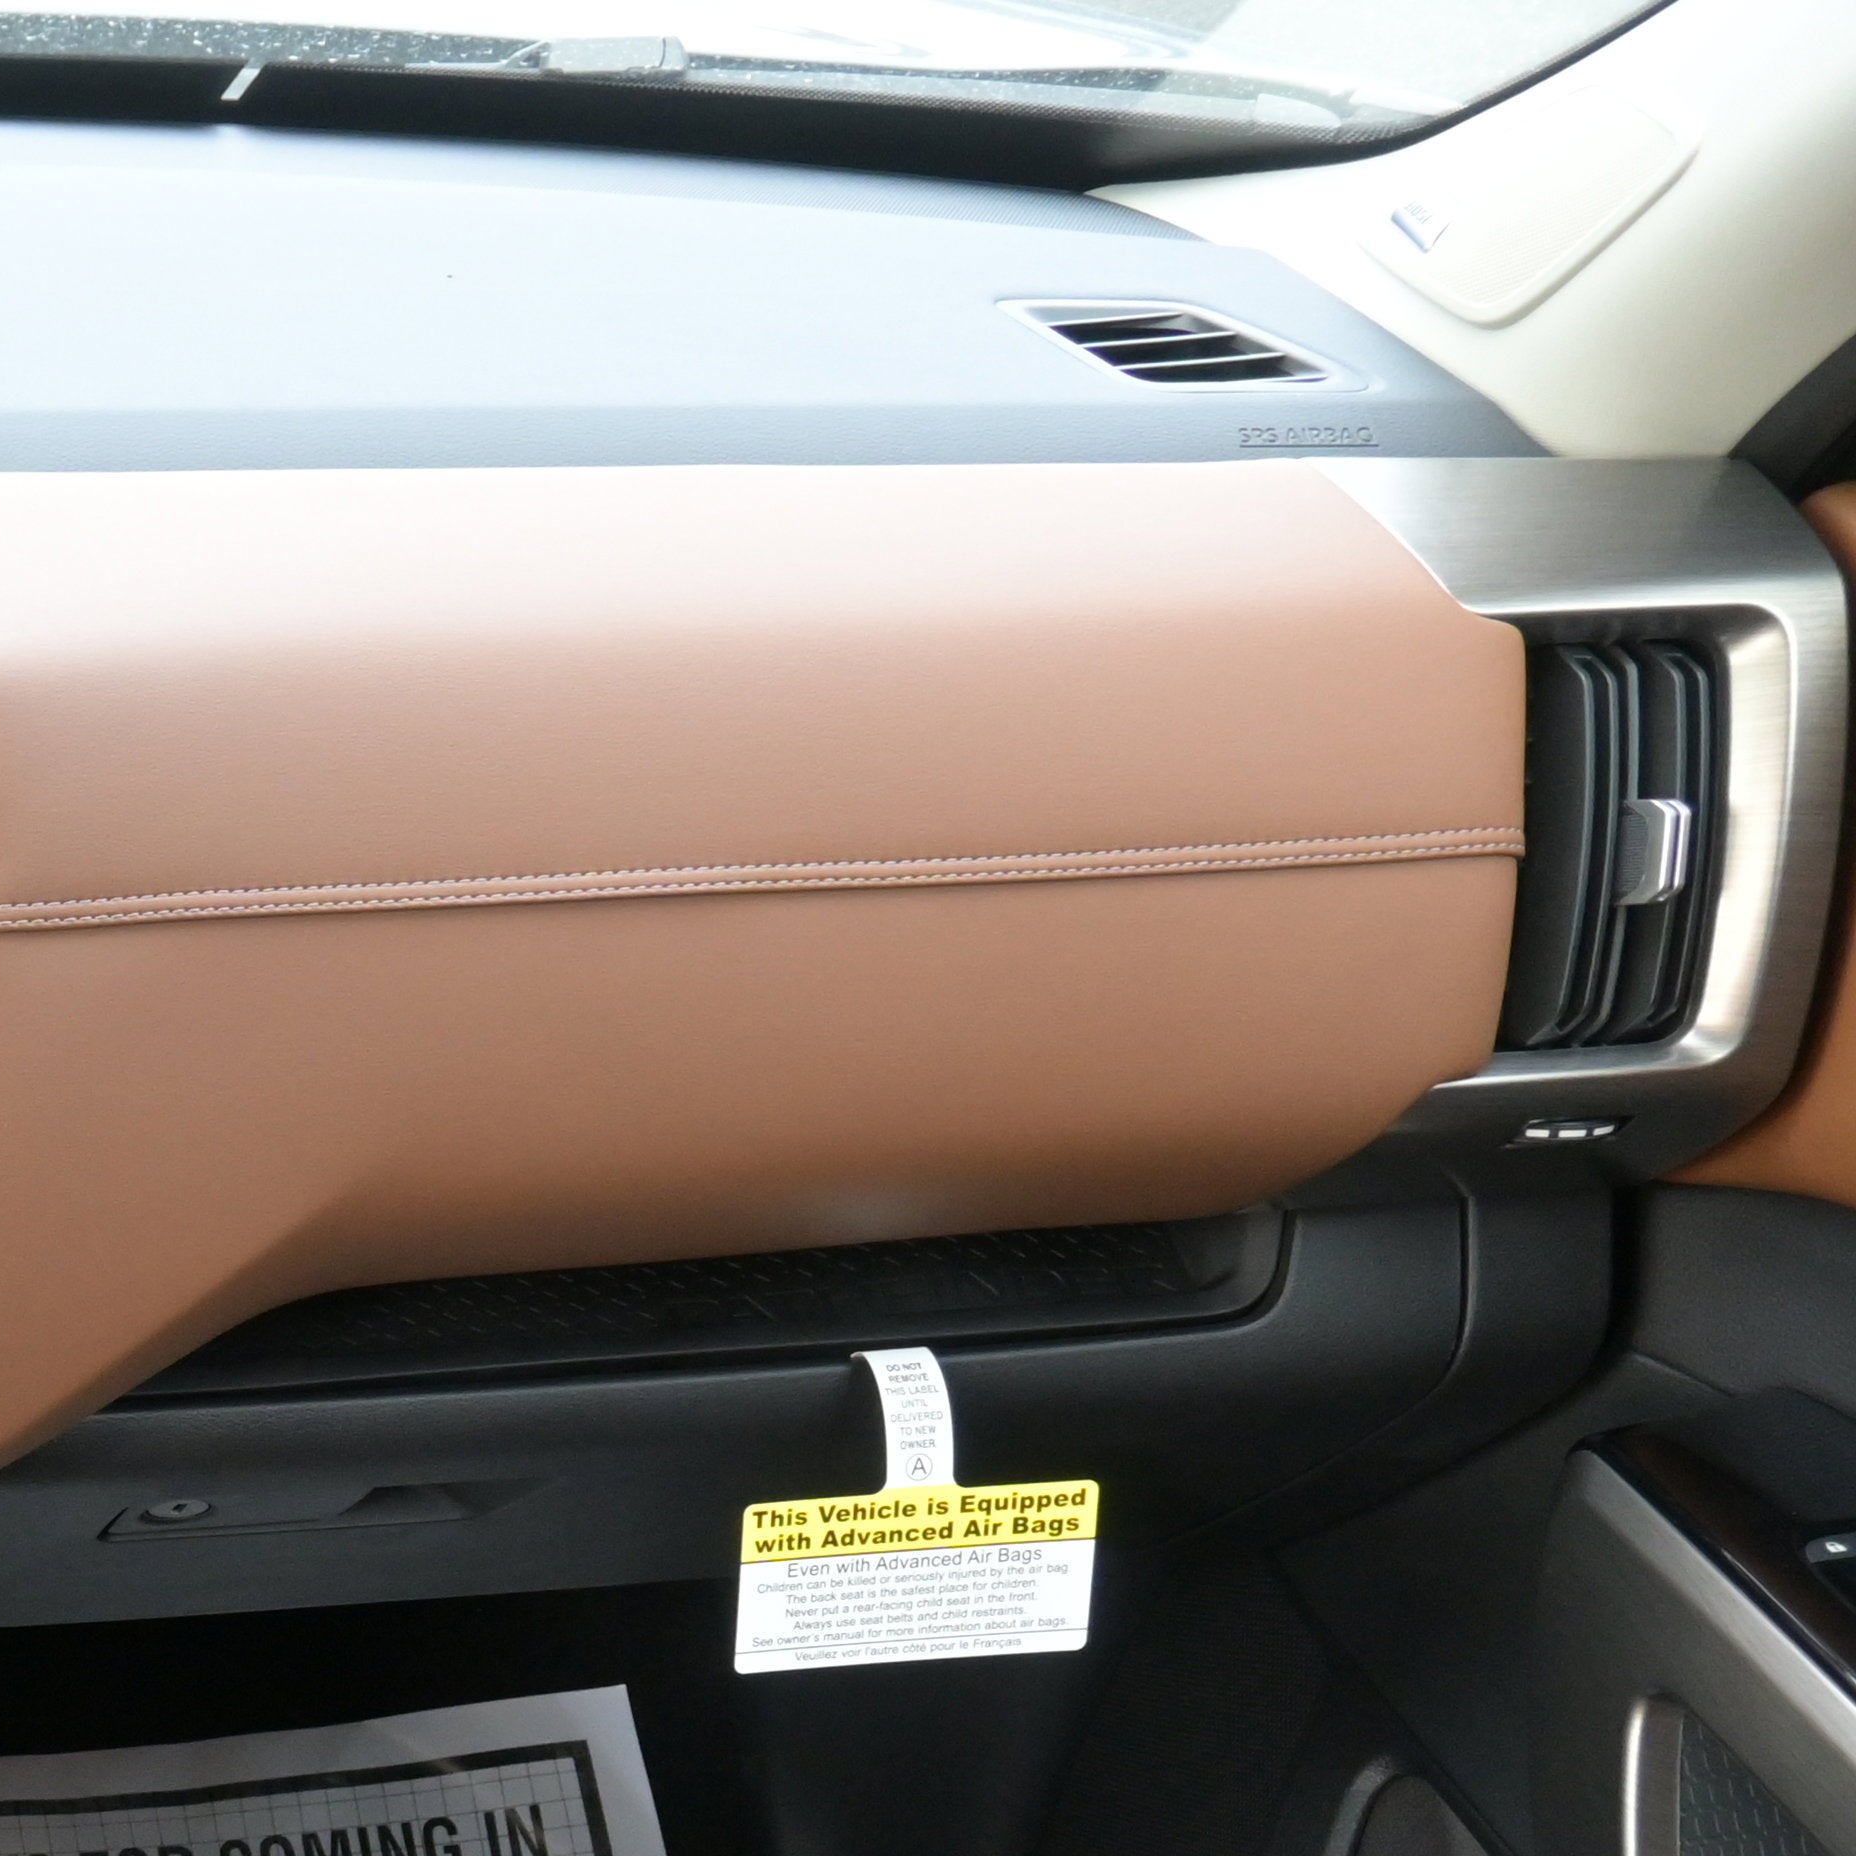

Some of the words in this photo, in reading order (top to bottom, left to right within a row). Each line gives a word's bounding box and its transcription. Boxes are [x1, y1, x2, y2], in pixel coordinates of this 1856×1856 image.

[753, 1509, 808, 1528] This
[819, 1500, 916, 1523] Vehicle
[928, 1498, 948, 1515] is
[960, 1488, 1086, 1516] Equipped
[755, 1533, 811, 1553] with
[821, 1521, 953, 1548] Advanced
[964, 1519, 1003, 1538] Air
[1012, 1516, 1080, 1537] Bags
[788, 1563, 830, 1578] Even
[837, 1558, 870, 1574] with
[876, 1551, 962, 1571] Advanced
[968, 1550, 992, 1564] Air
[999, 1548, 1042, 1565] Bags
